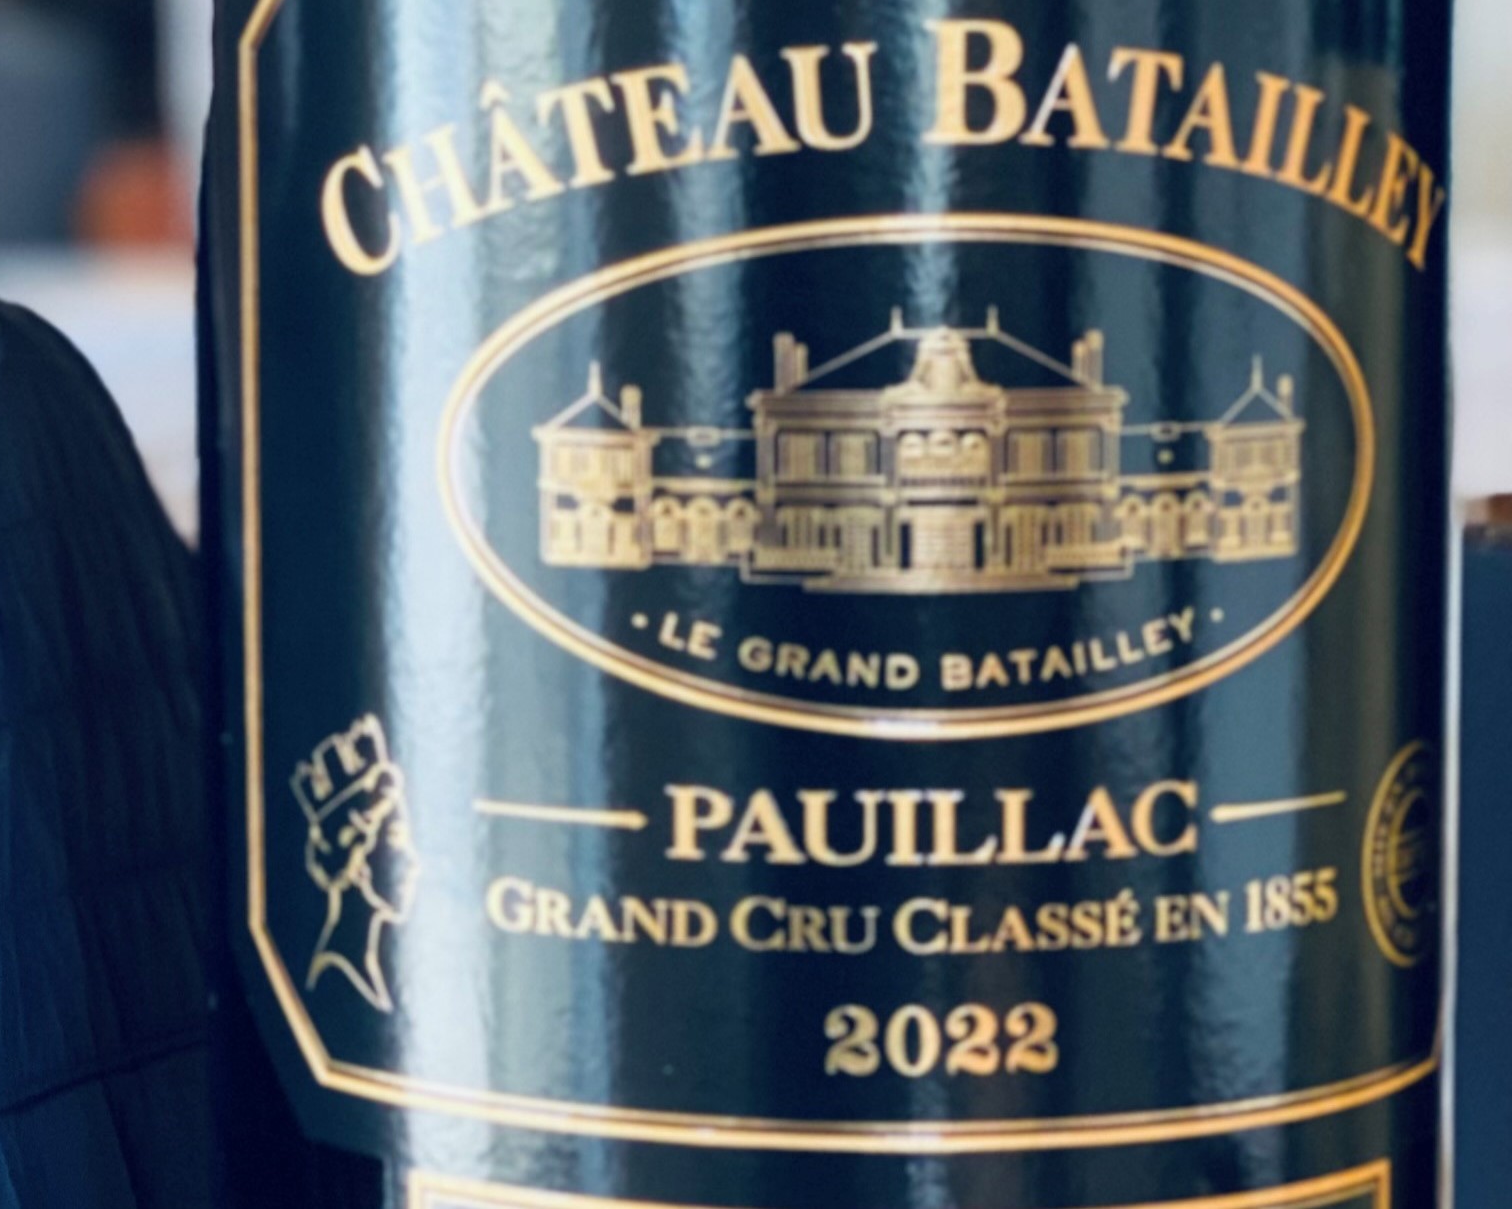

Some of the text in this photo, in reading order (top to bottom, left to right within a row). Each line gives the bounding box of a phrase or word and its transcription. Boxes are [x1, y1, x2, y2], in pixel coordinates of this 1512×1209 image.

[321, 19, 1446, 274] CHÂTEAU BATAILLEY
[659, 607, 1196, 690] LE GRAND BATAILLEY
[664, 779, 1199, 866] PAUILLAC
[487, 868, 1338, 954] GRAND CRU CLASSÉ EN 1855
[824, 1003, 1058, 1077] 2022
